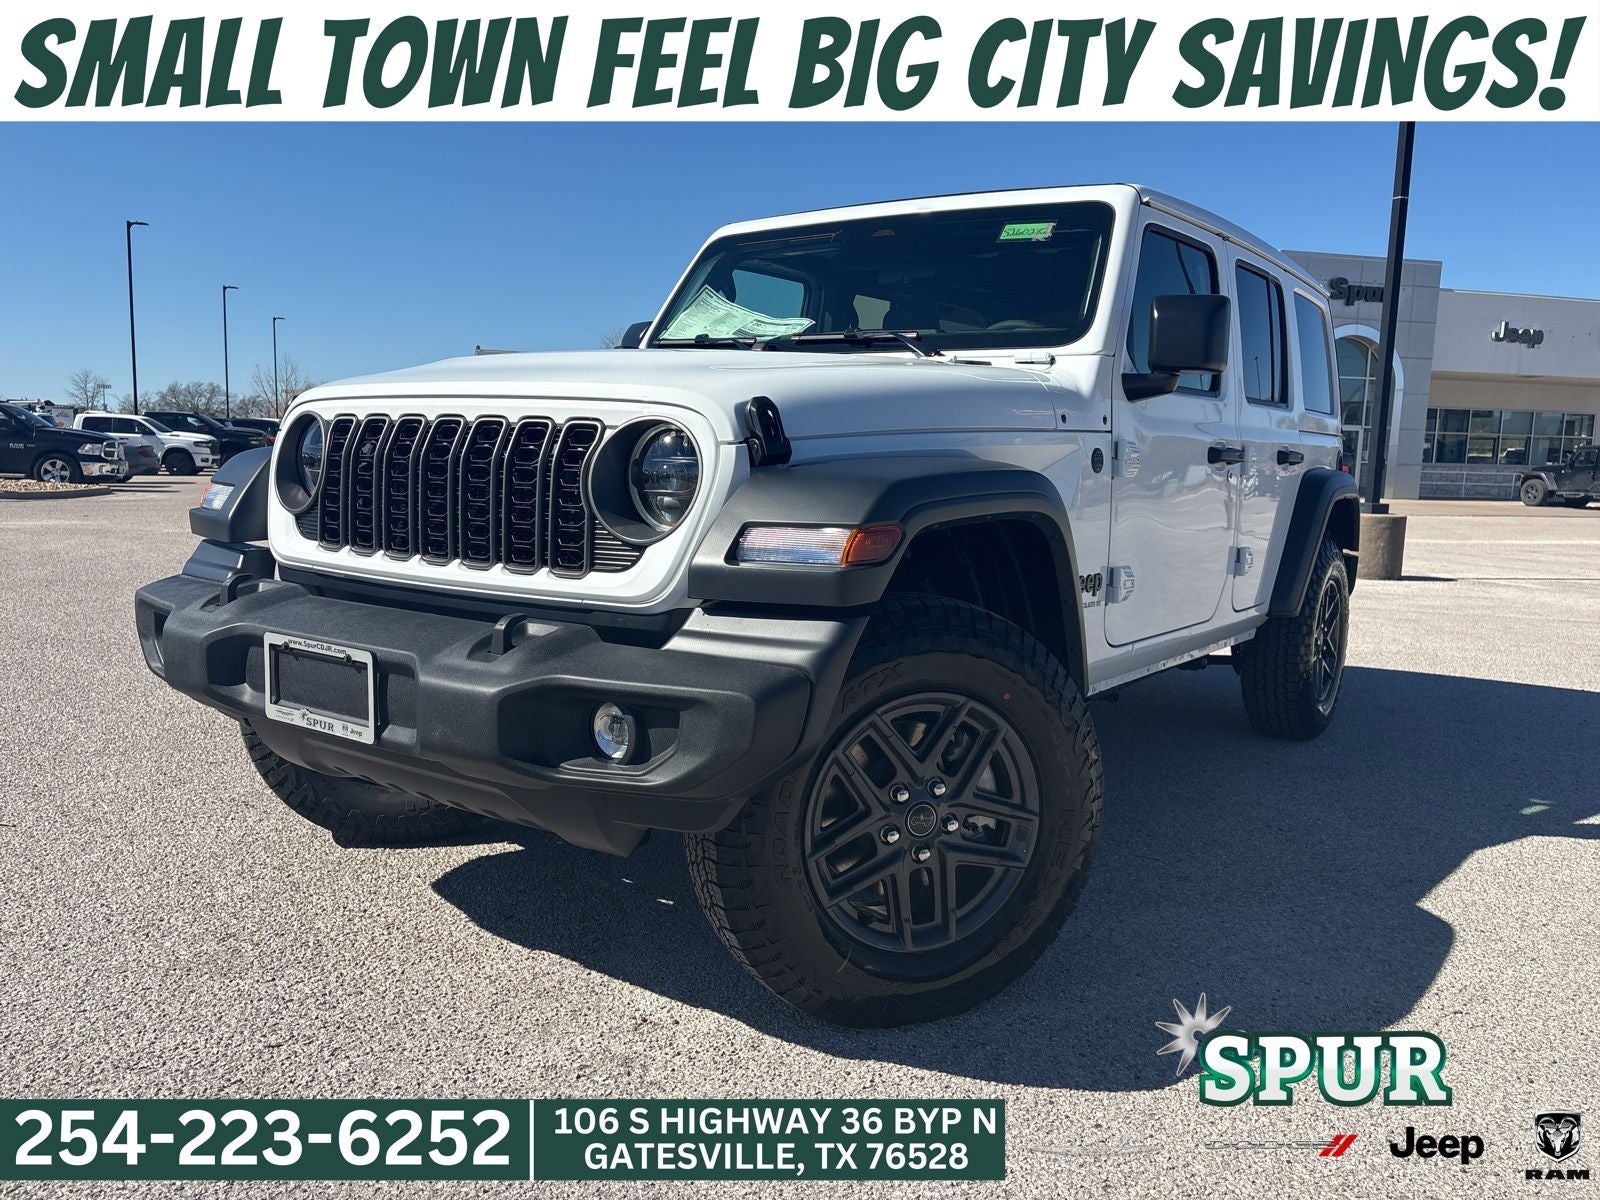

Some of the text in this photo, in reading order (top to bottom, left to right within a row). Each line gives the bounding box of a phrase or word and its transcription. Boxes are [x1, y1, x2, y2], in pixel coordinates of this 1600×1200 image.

[1330, 277, 1384, 306] Spu
[1491, 321, 1545, 348] Jeep
[1079, 572, 1103, 597] eep
[288, 639, 346, 655] www.SpurCDJR.com
[306, 718, 334, 732] SPUR
[771, 775, 799, 888] ROAD
